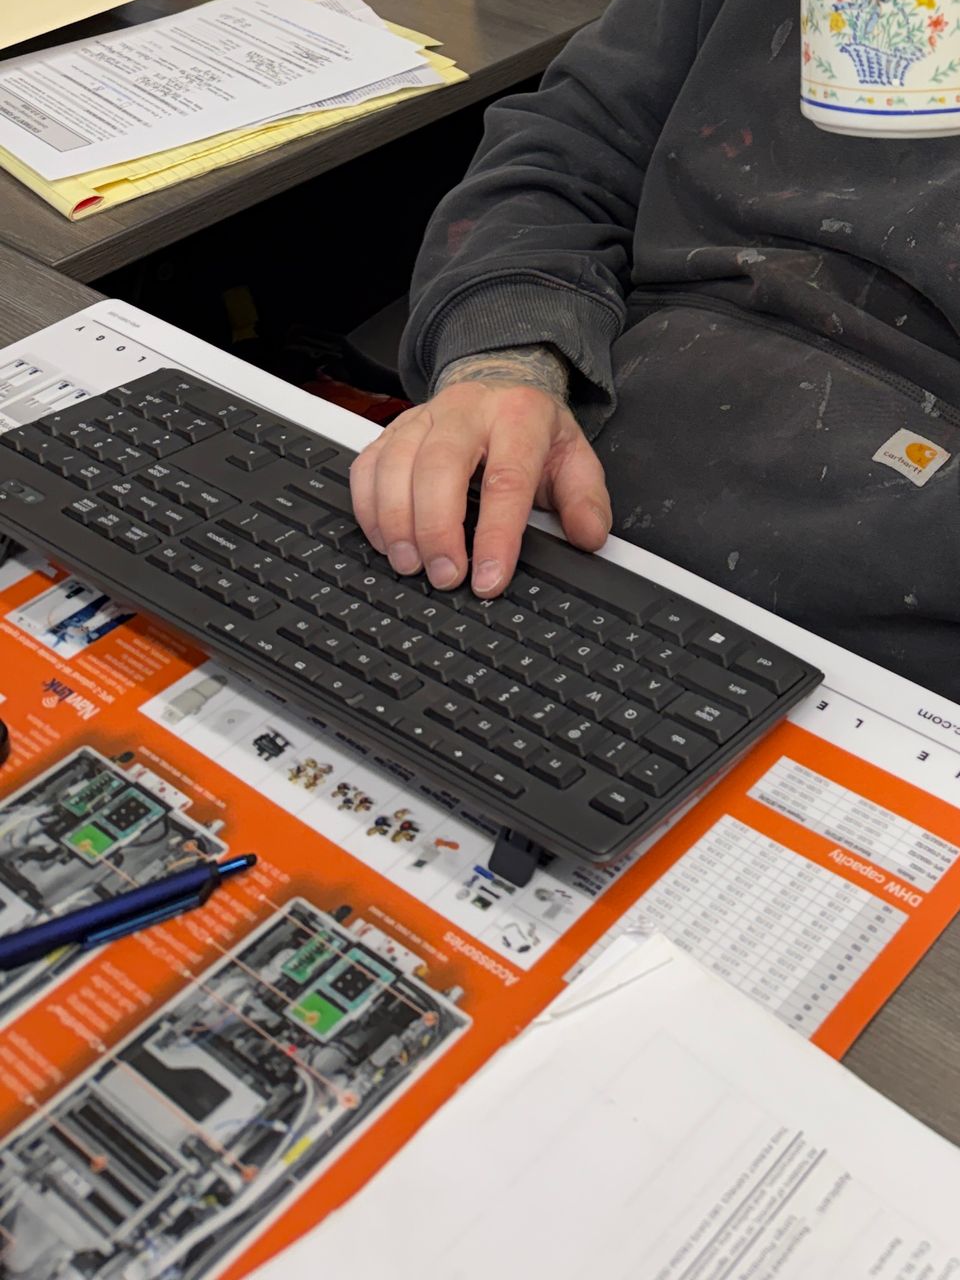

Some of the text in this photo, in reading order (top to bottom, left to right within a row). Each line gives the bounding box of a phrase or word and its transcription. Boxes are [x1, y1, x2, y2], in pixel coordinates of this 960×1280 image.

[883, 451, 923, 475] carhartt
[827, 848, 924, 908] DHW capacity
[441, 930, 521, 987] Accessories
